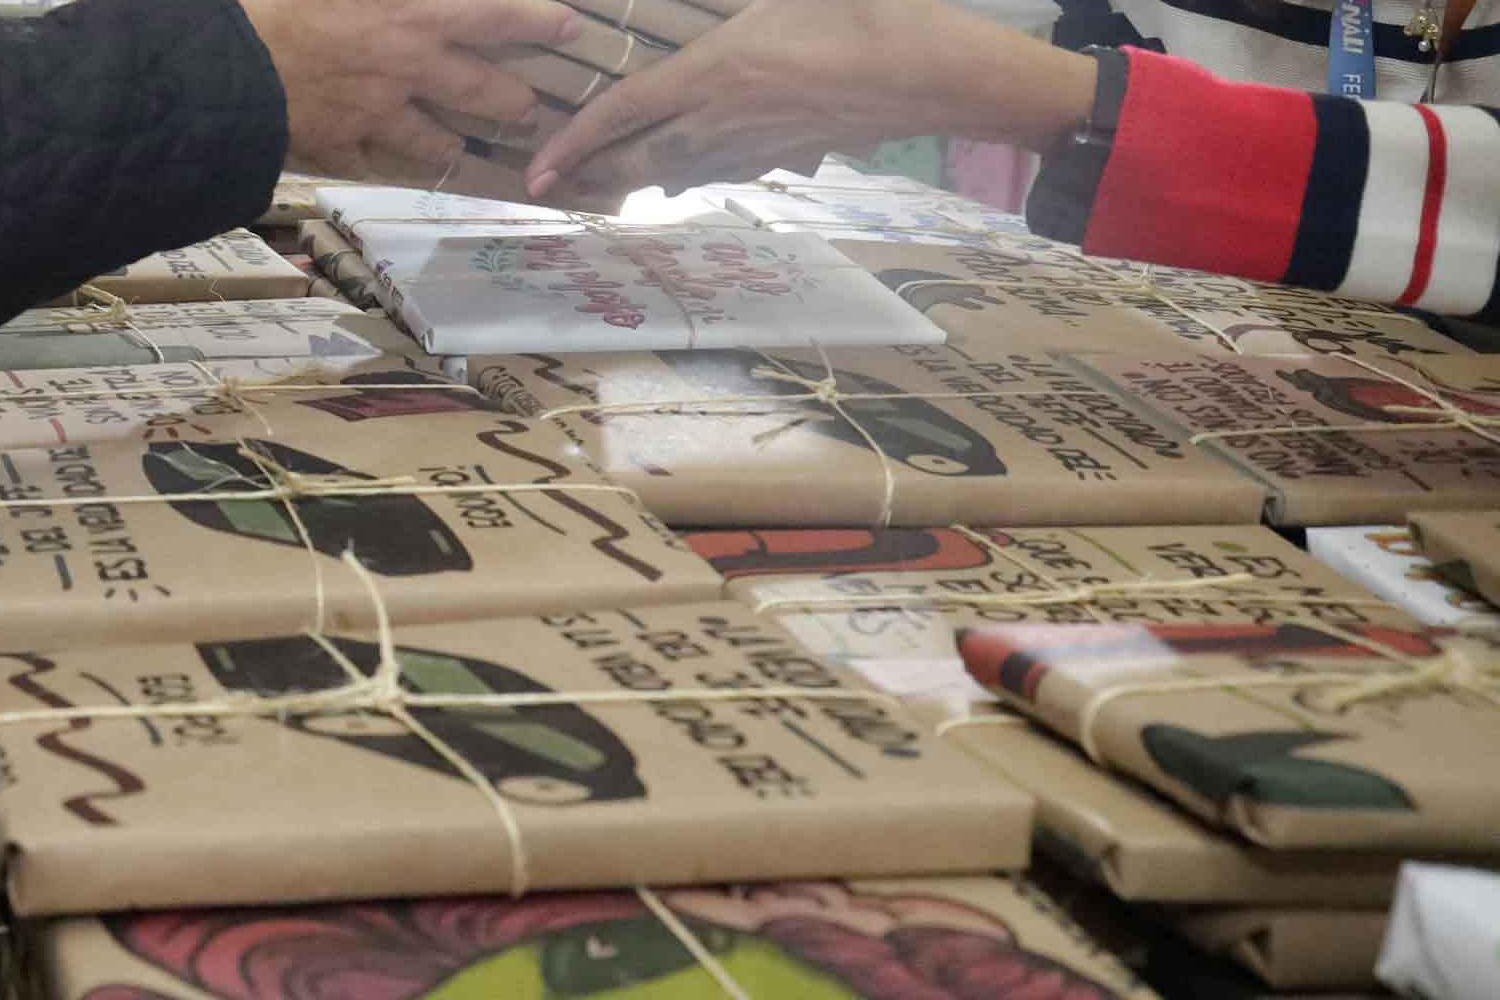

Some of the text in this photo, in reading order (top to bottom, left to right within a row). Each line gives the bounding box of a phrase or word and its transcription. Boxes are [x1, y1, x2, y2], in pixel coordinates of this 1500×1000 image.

[55, 464, 127, 535] VELOIDAD
[418, 465, 514, 529] EQUIO!
[94, 557, 149, 581] ES
[137, 674, 242, 746] EQUPO!
[591, 651, 748, 752] VELOIDAD
